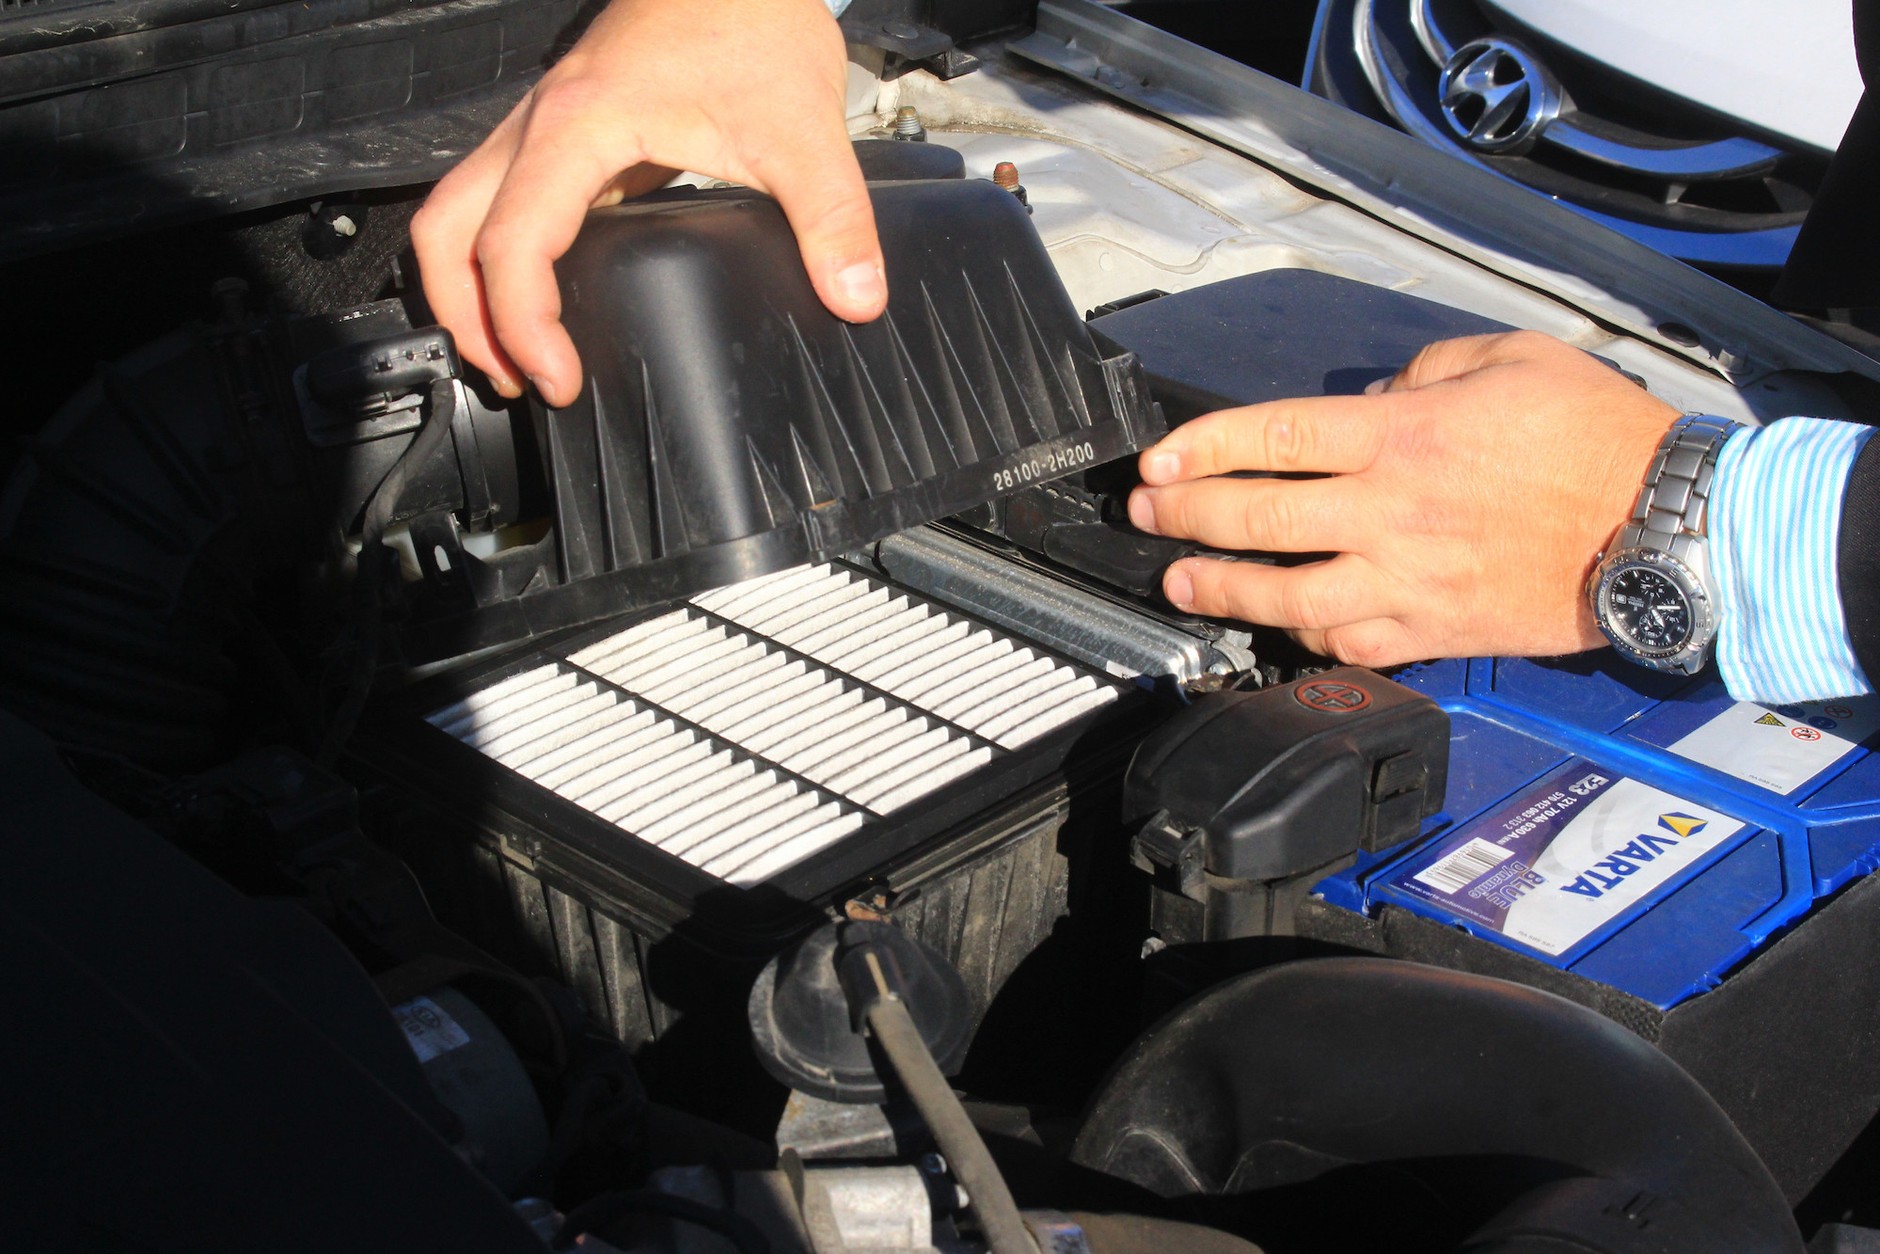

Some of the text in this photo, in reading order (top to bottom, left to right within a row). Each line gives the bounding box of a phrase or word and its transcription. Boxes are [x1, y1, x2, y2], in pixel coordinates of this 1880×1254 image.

[993, 441, 1094, 491] 28100-2H200
[1568, 773, 1609, 795] E23
[1534, 799, 1551, 810] 412
[1548, 791, 1565, 802] 570
[1557, 797, 1577, 809] 12V
[1509, 815, 1526, 827] 313
[1532, 807, 1560, 823] 70Ah
[1559, 833, 1679, 899] VARTA
[1468, 860, 1528, 899] Dynamic
[1486, 869, 1546, 910] BLUE
